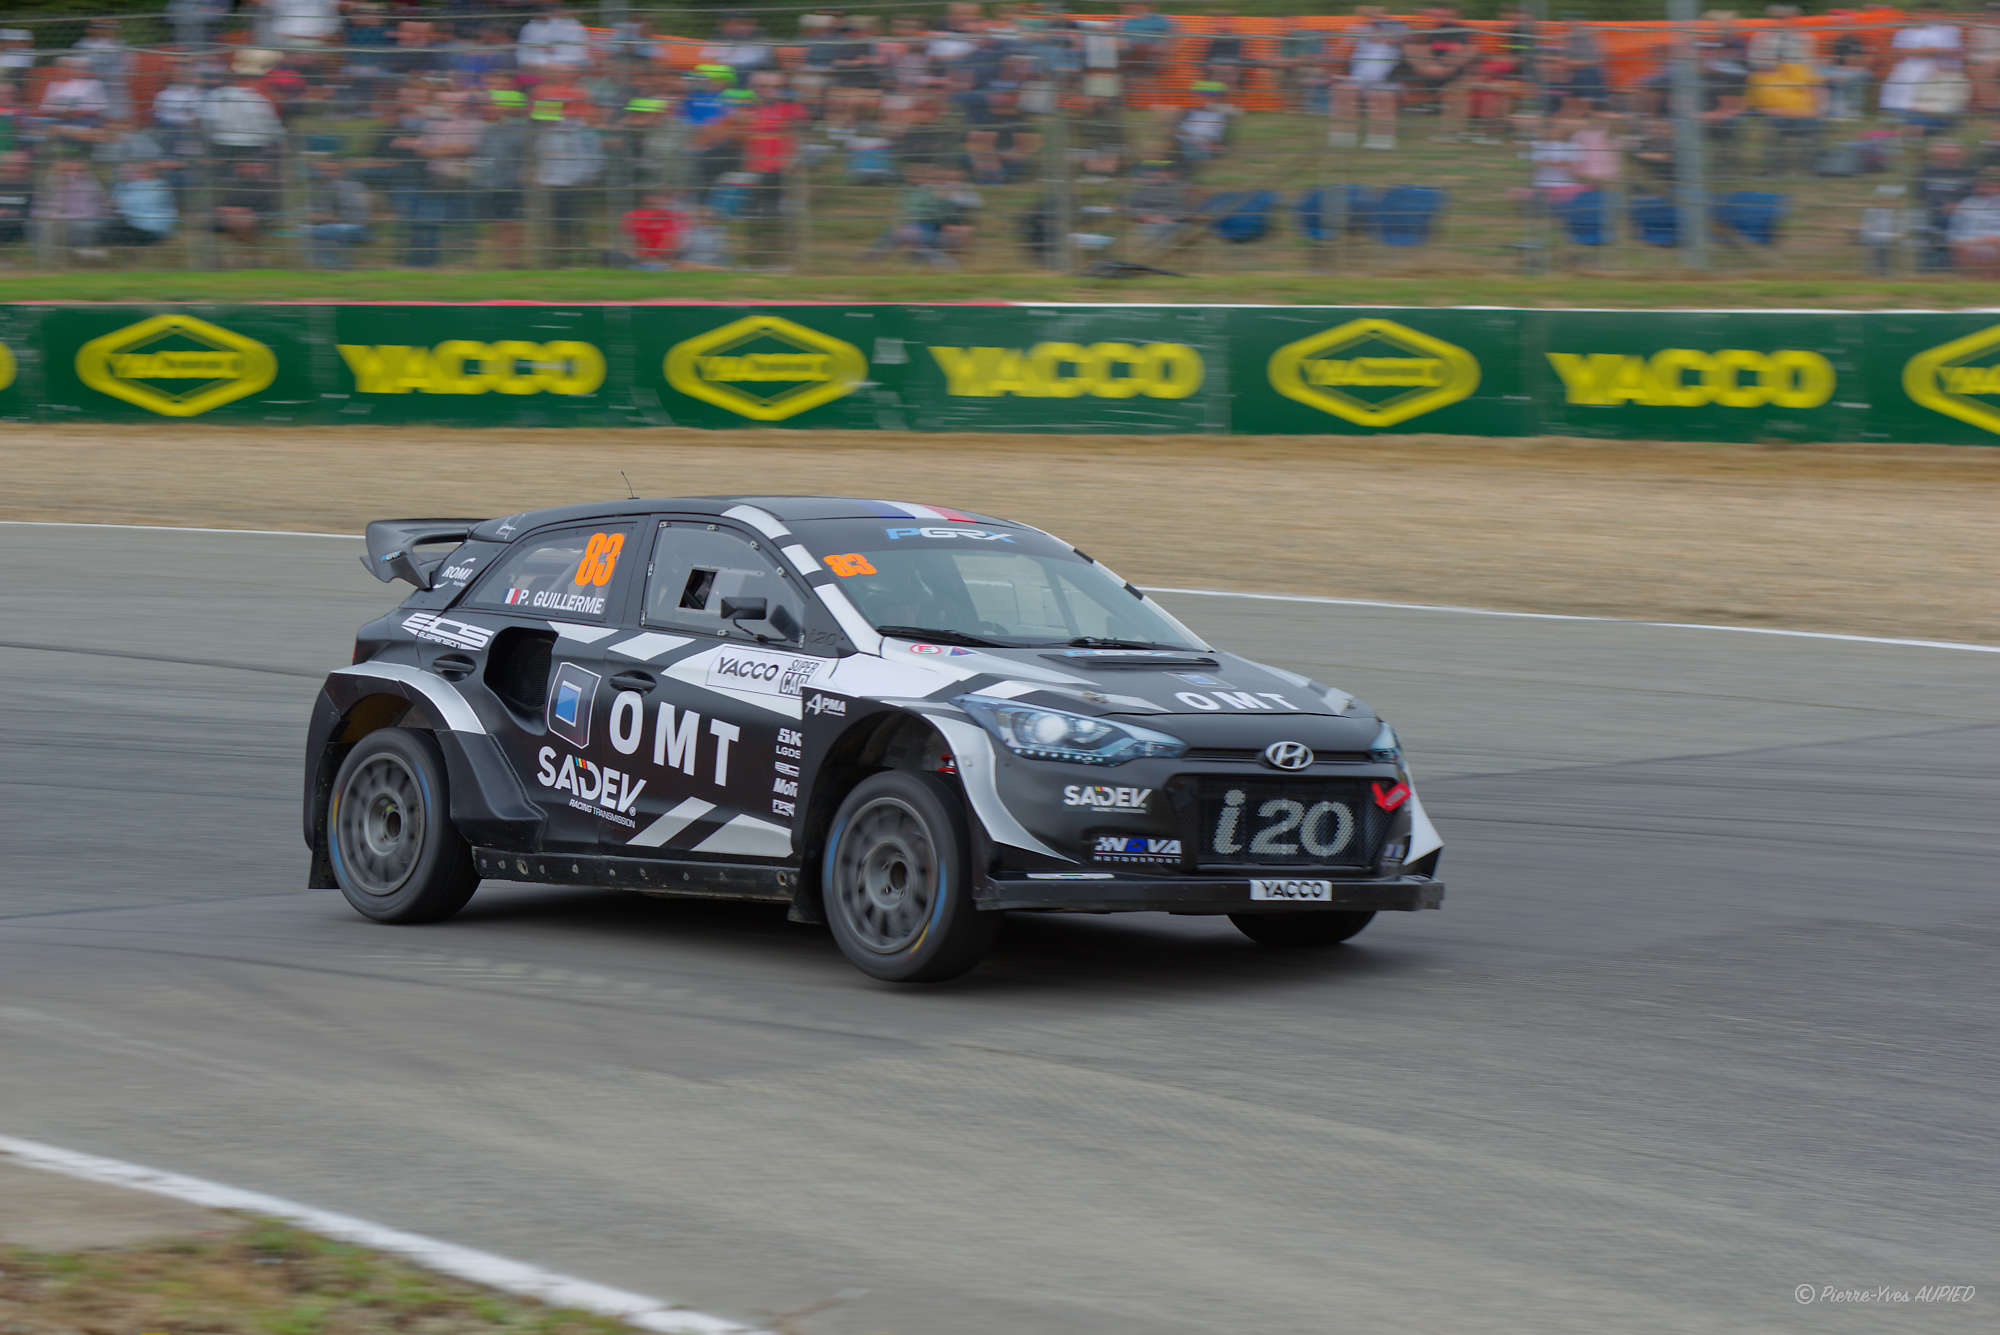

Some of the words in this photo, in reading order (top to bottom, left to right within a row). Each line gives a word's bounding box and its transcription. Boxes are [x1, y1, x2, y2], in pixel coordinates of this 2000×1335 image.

[335, 339, 606, 395] YACCO
[928, 341, 1204, 398] YACCO
[1546, 348, 1835, 408] YACCO
[885, 527, 1017, 544] PGRX
[574, 532, 625, 587] 83
[823, 553, 878, 577] 83
[533, 591, 605, 615] GUILLERME
[717, 656, 779, 682] YACCO
[787, 659, 820, 674] SUPER
[1174, 691, 1300, 711] OMT
[609, 690, 740, 787] OMT
[1063, 785, 1152, 808] SADEV
[568, 798, 593, 813] RACING
[593, 806, 637, 829] TRANSMISSION
[1261, 881, 1324, 898] YACCO
